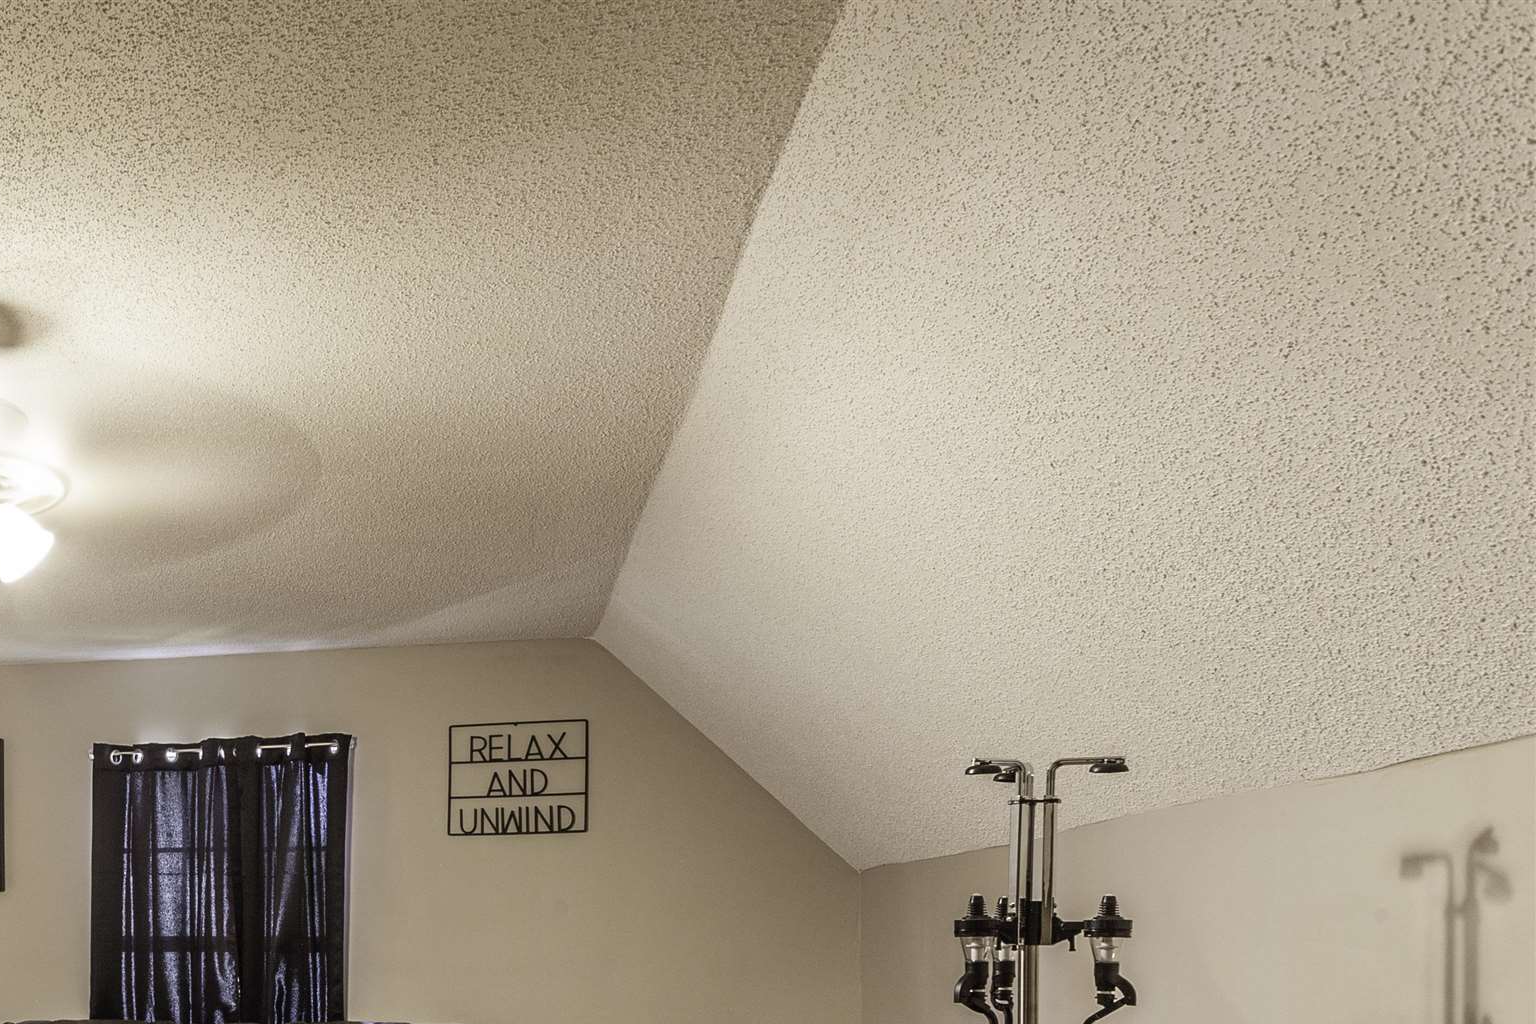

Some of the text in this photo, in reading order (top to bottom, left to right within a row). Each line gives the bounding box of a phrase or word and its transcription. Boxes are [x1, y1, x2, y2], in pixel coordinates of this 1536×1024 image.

[470, 732, 568, 762] RELAX
[487, 768, 548, 796] AND
[460, 805, 576, 834] UNWIND
